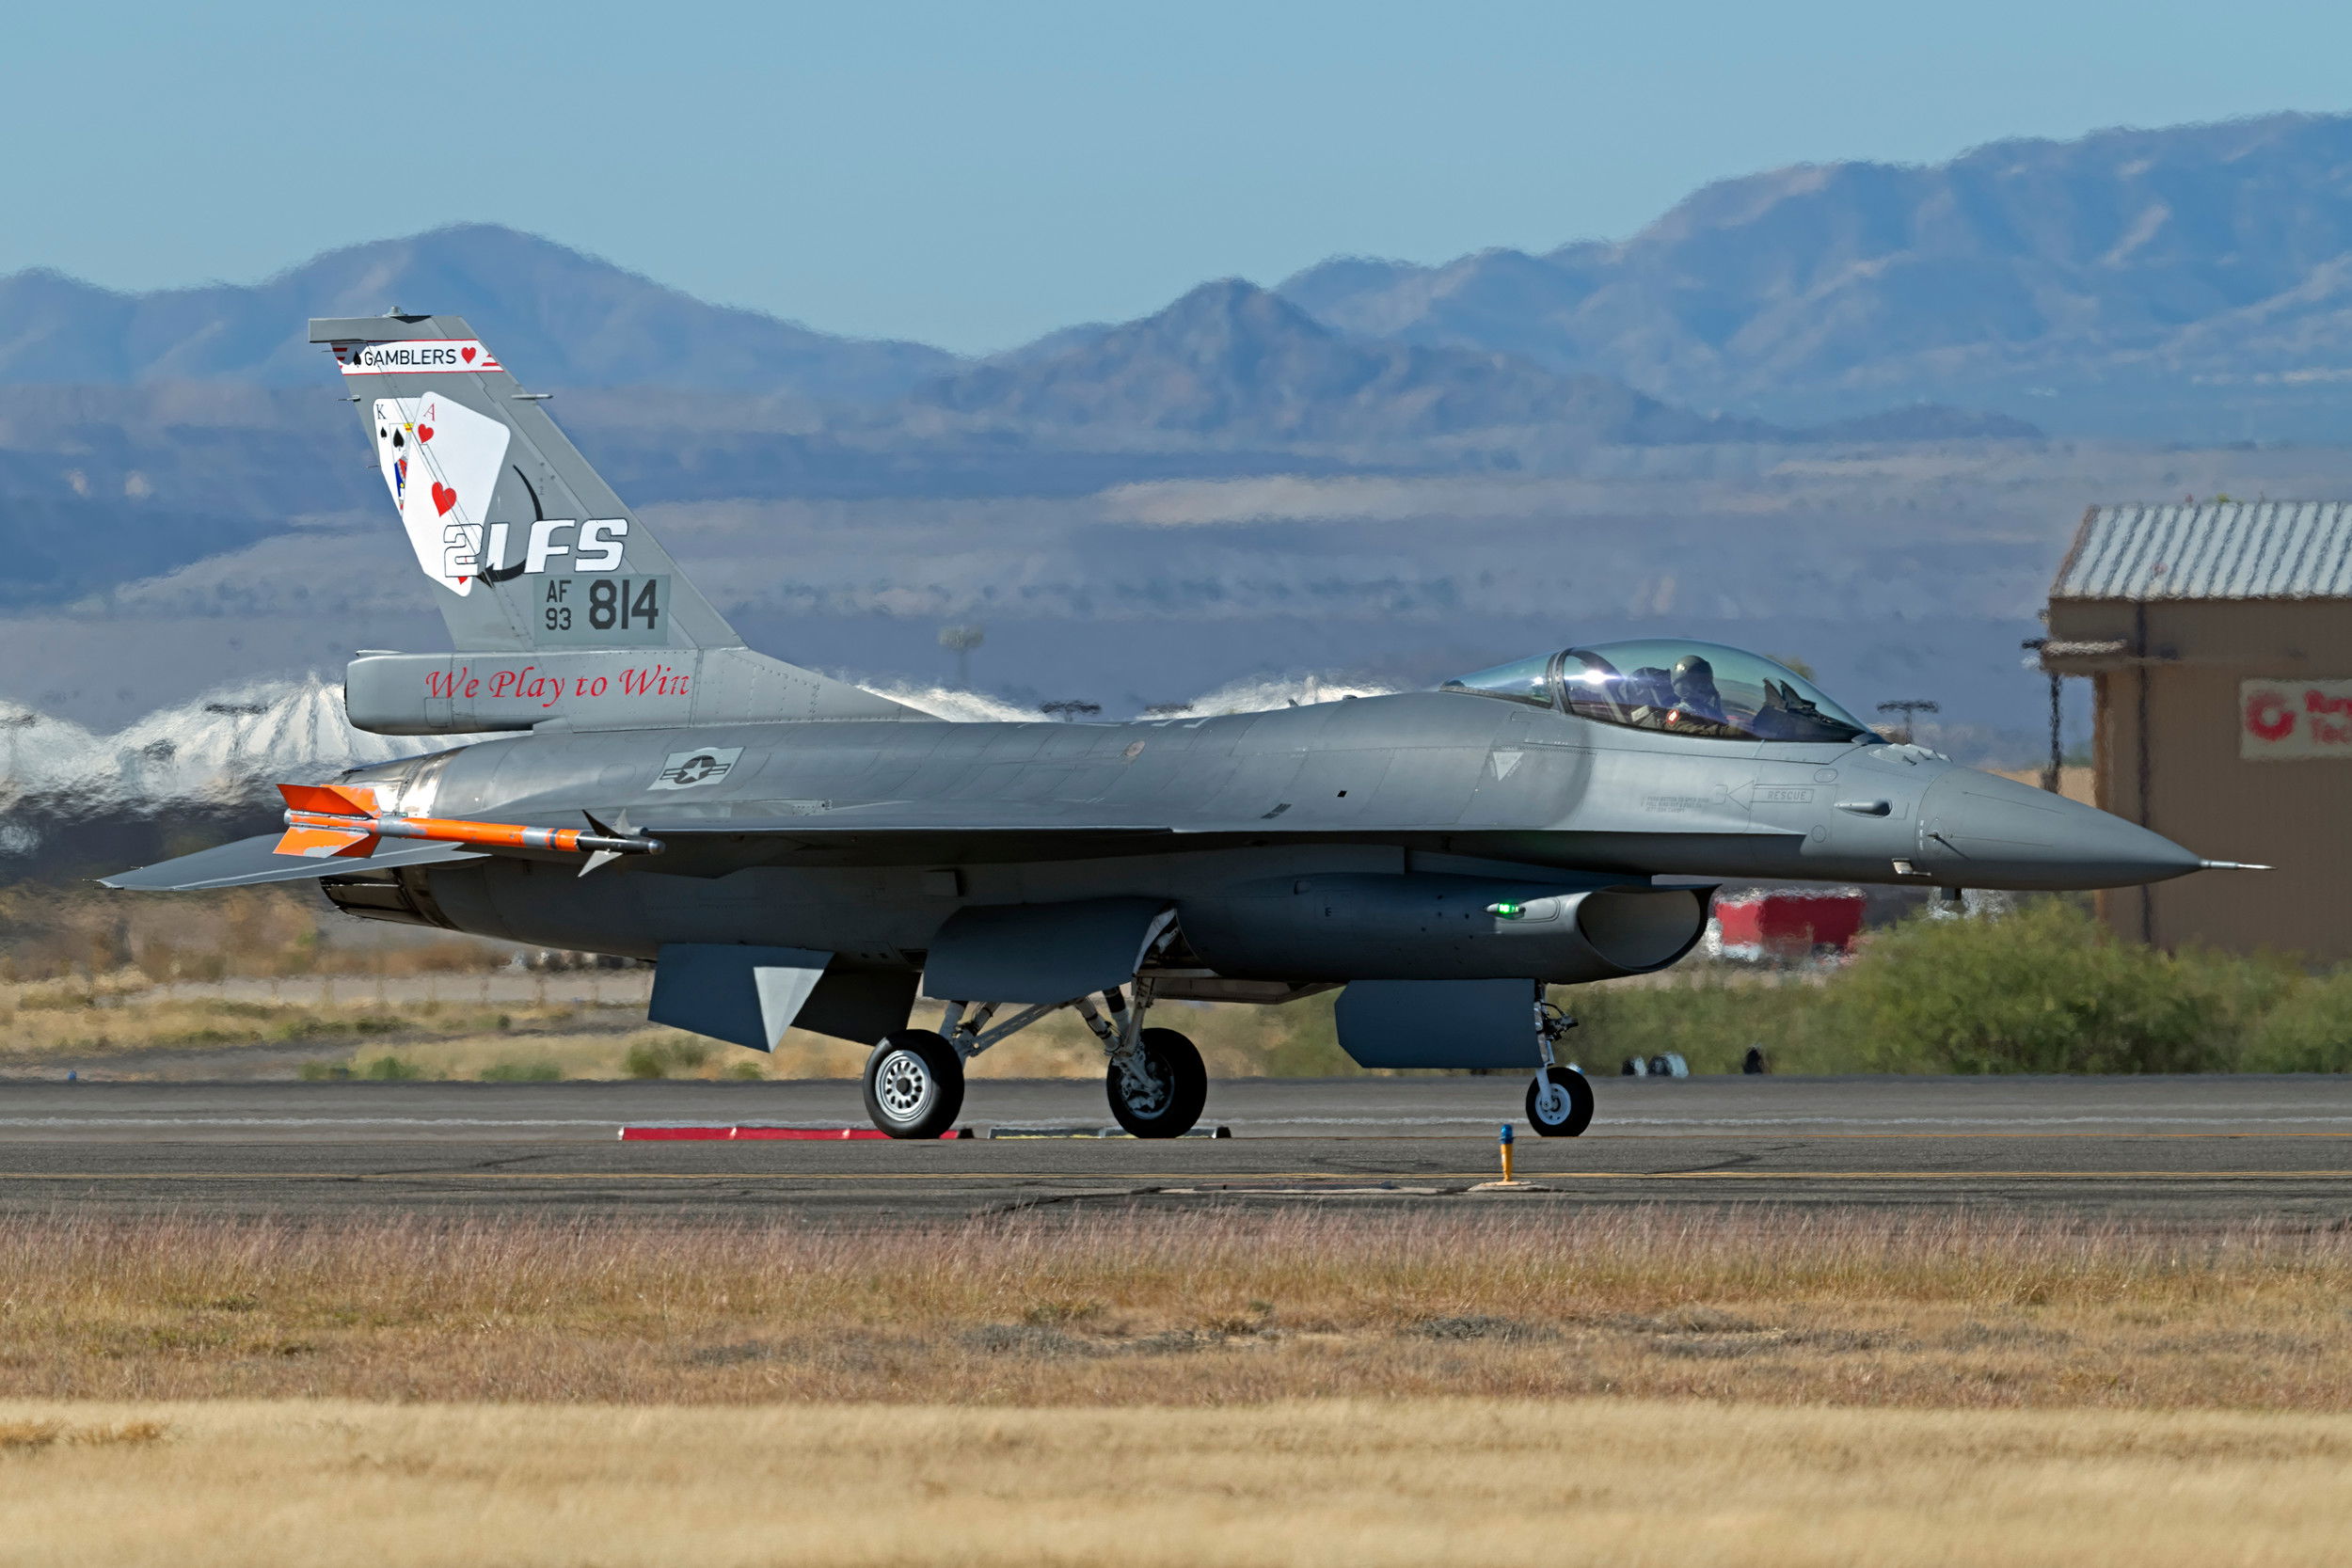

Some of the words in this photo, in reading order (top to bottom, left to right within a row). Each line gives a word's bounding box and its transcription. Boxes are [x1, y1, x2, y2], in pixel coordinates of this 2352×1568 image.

[364, 349, 456, 367] GAMBLERS
[375, 404, 387, 420] K
[423, 403, 436, 421] A
[546, 579, 572, 603] AF
[589, 579, 660, 630] 814
[546, 608, 572, 631] 93
[425, 666, 480, 699] We
[489, 666, 565, 708] Play
[576, 675, 608, 697] to
[619, 664, 692, 696] Win
[1768, 790, 1807, 800] RESCUE
